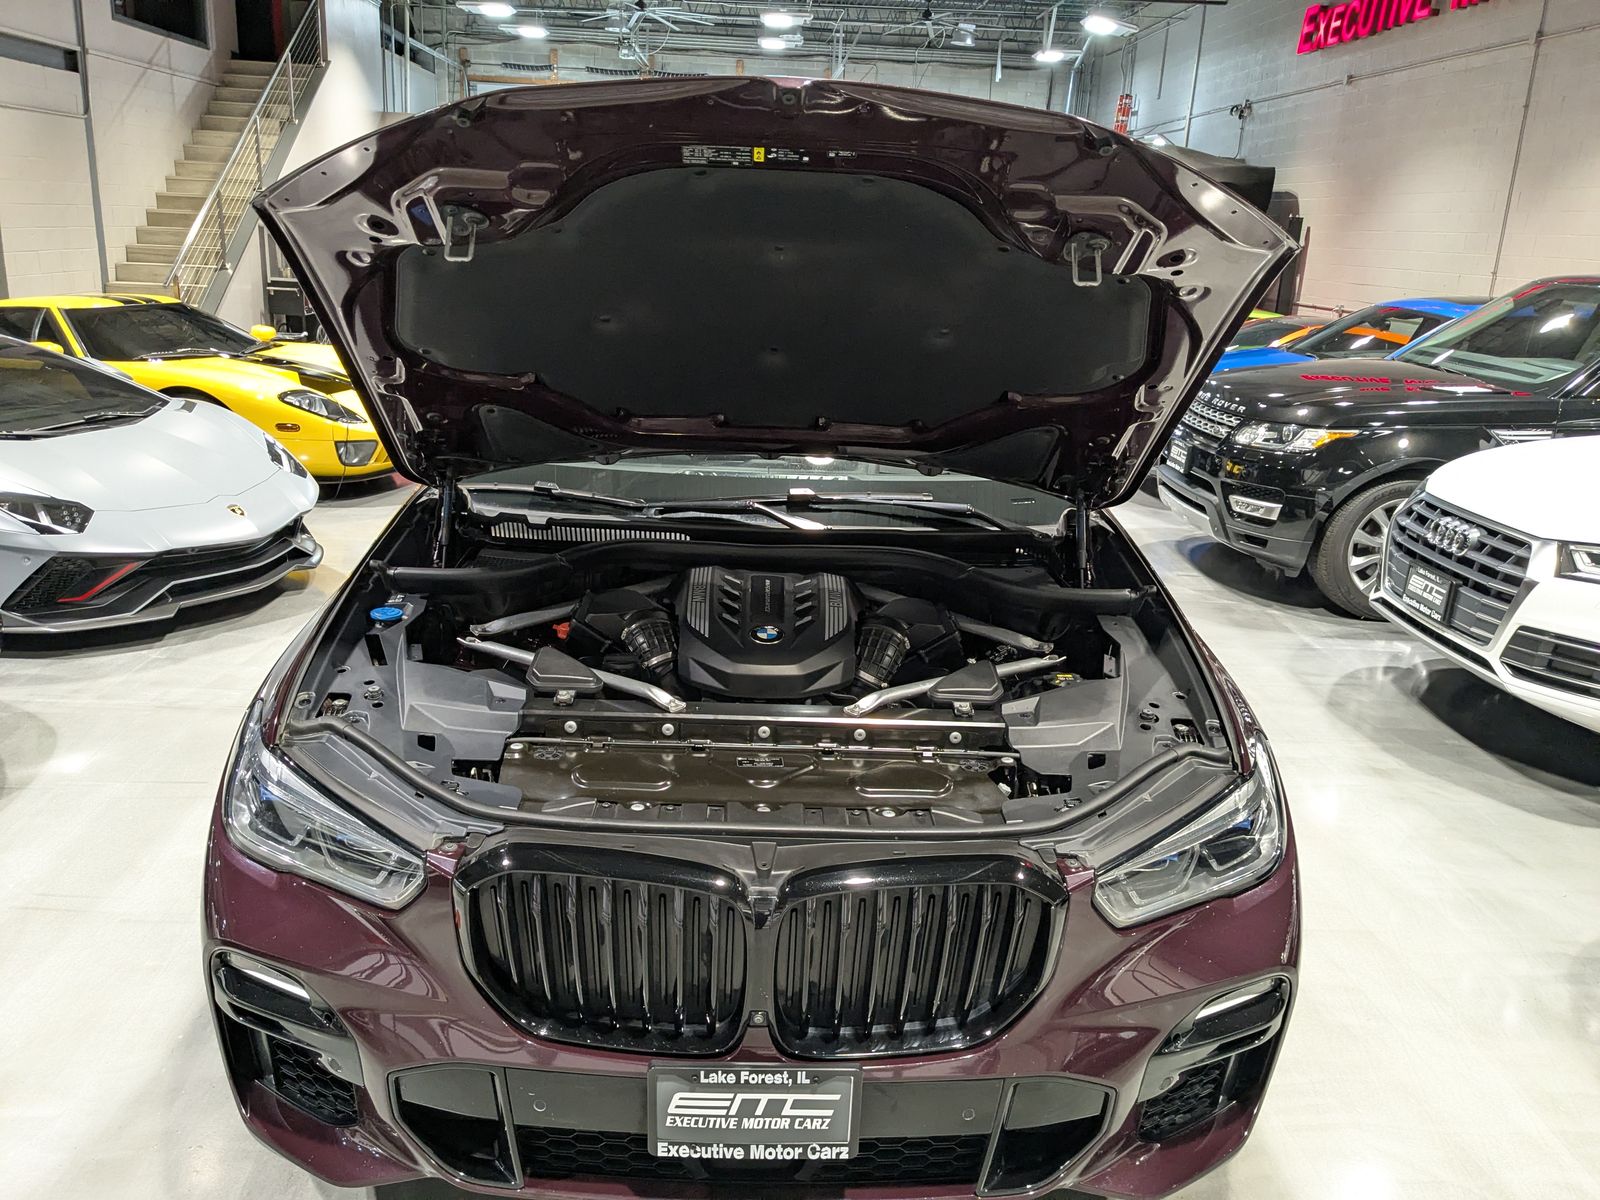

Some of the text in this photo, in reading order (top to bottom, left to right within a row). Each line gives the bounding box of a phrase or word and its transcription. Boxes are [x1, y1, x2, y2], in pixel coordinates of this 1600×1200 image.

[1211, 397, 1246, 413] ROVER
[700, 1071, 810, 1086] Lake Forest, IL
[665, 1116, 831, 1130] EXECUTIVE MOTOR CARZ
[657, 1142, 849, 1160] Executive Motor Carz
